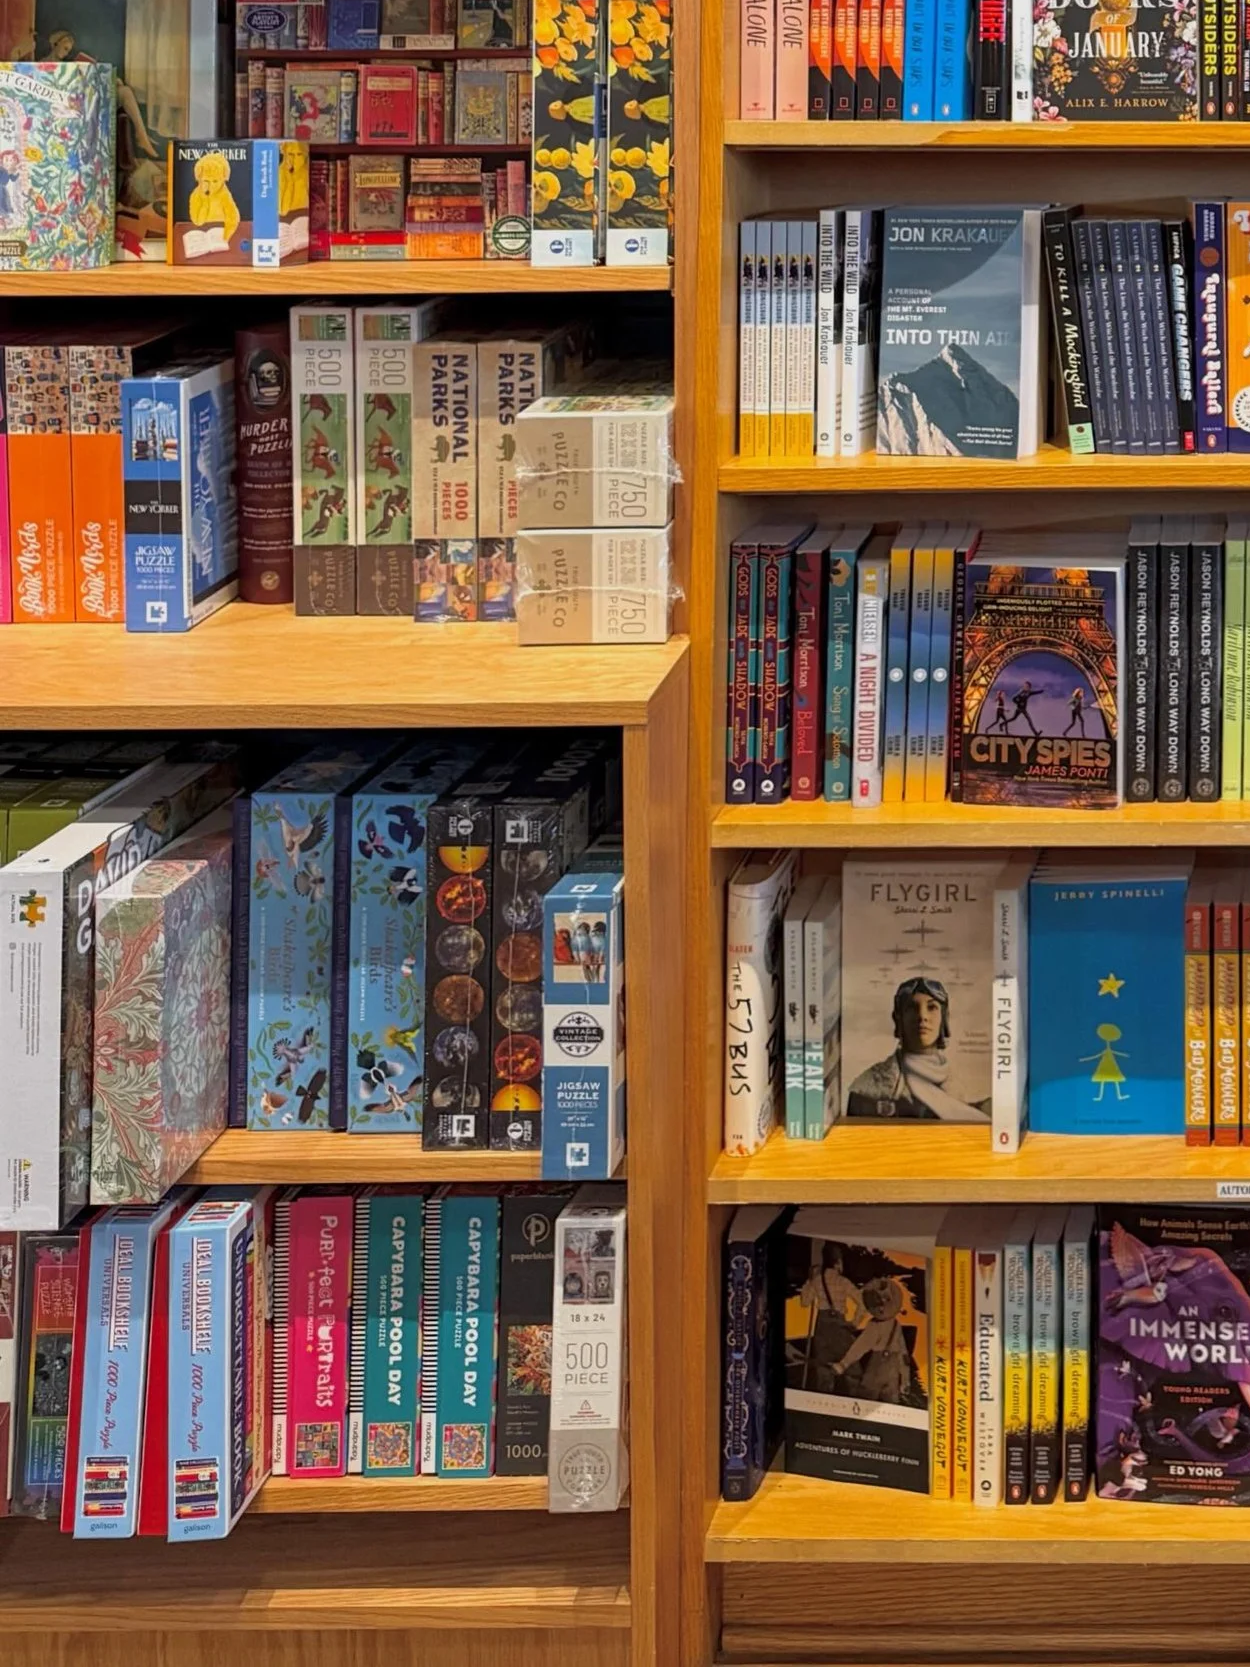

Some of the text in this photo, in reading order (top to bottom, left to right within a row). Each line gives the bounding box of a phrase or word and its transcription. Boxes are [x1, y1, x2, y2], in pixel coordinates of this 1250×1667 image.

[1068, 31, 1165, 60] JANUARY
[1066, 97, 1168, 109] ALIX E. HARROW
[889, 228, 924, 242] JON
[886, 329, 979, 346] INTO THIN
[432, 354, 448, 428] PARKS
[451, 354, 468, 463] NATIONAL
[129, 505, 178, 514] NEW YORKER
[134, 546, 176, 556] JIGSAW
[136, 557, 175, 566] PUZZLE
[968, 736, 1112, 768] CITY SPIES
[1024, 765, 1109, 778] JAMES PONTI
[871, 883, 977, 903] FLYGIRL
[1055, 887, 1166, 902] JERRY SPINELLI
[557, 1082, 600, 1090] JIGSAW
[557, 1092, 599, 1100] PUZZLE
[388, 1216, 406, 1407] CAPYBARA POOL DAY
[1177, 1305, 1199, 1317] AN
[1129, 1316, 1250, 1341] IMMENSE
[565, 1342, 608, 1370] 500
[978, 1313, 995, 1402] Educated
[564, 1372, 608, 1384] PIECE
[1169, 1465, 1224, 1478] ED YONG
